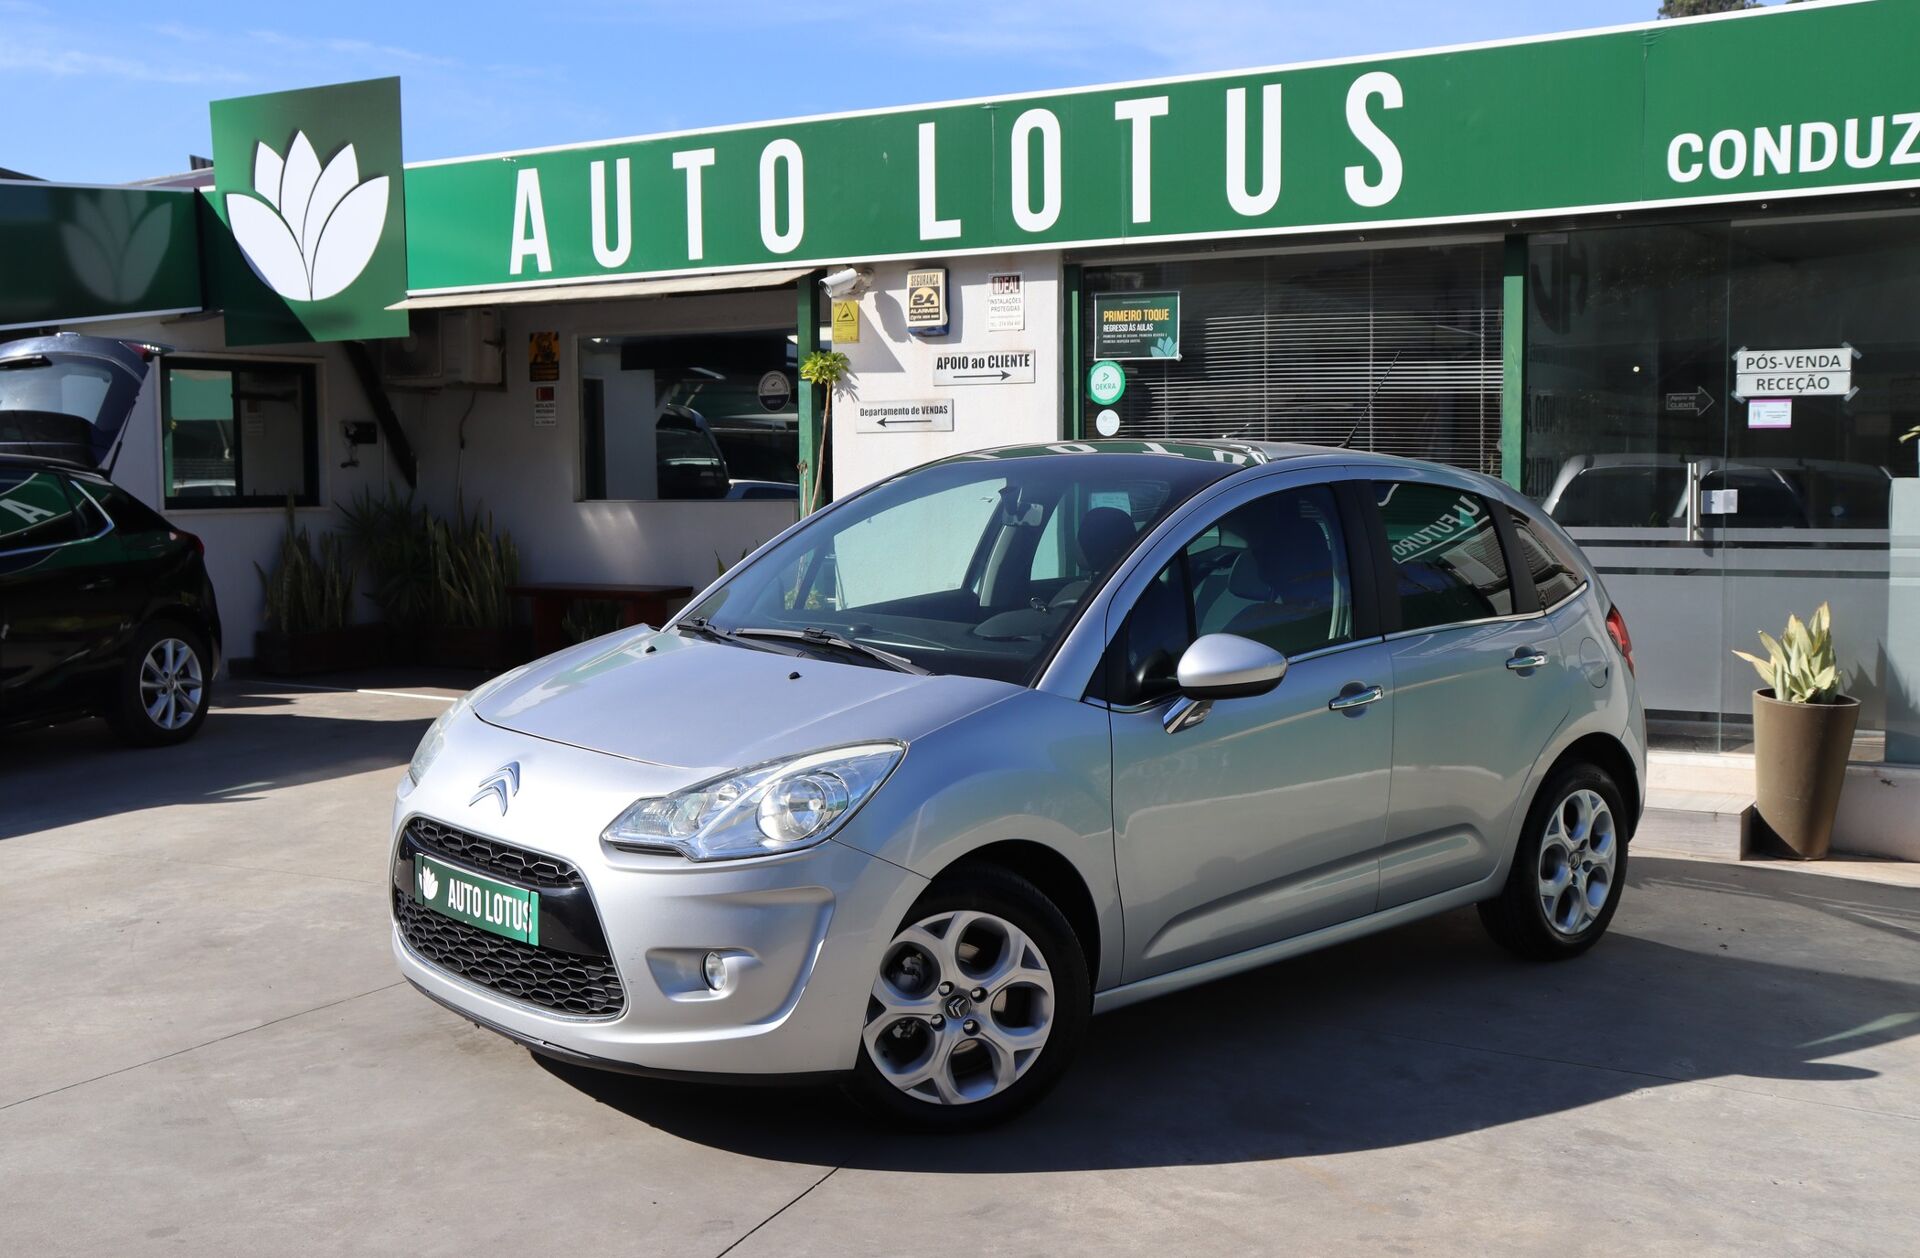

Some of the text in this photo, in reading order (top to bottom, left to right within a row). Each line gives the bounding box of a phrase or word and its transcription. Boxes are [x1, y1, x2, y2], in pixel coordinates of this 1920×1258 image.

[1667, 112, 1920, 183] CONDUZ
[508, 71, 1404, 276] AUTO LOTUS
[992, 276, 1020, 294] IDEAL
[913, 293, 935, 306] 24
[1103, 308, 1169, 322] PRIMEIRO TOQUE
[1103, 324, 1128, 332] REGRESSO
[1137, 323, 1154, 331] AULAS
[936, 354, 1030, 370] APOIO ao CLIENTE
[1746, 354, 1841, 370] PÓS-VENDA
[1095, 383, 1117, 391] DEKRA
[1756, 374, 1830, 393] RECEÇÃO
[860, 405, 948, 417] Departamento de VENDAS
[448, 878, 533, 934] AUTO LOTUS
